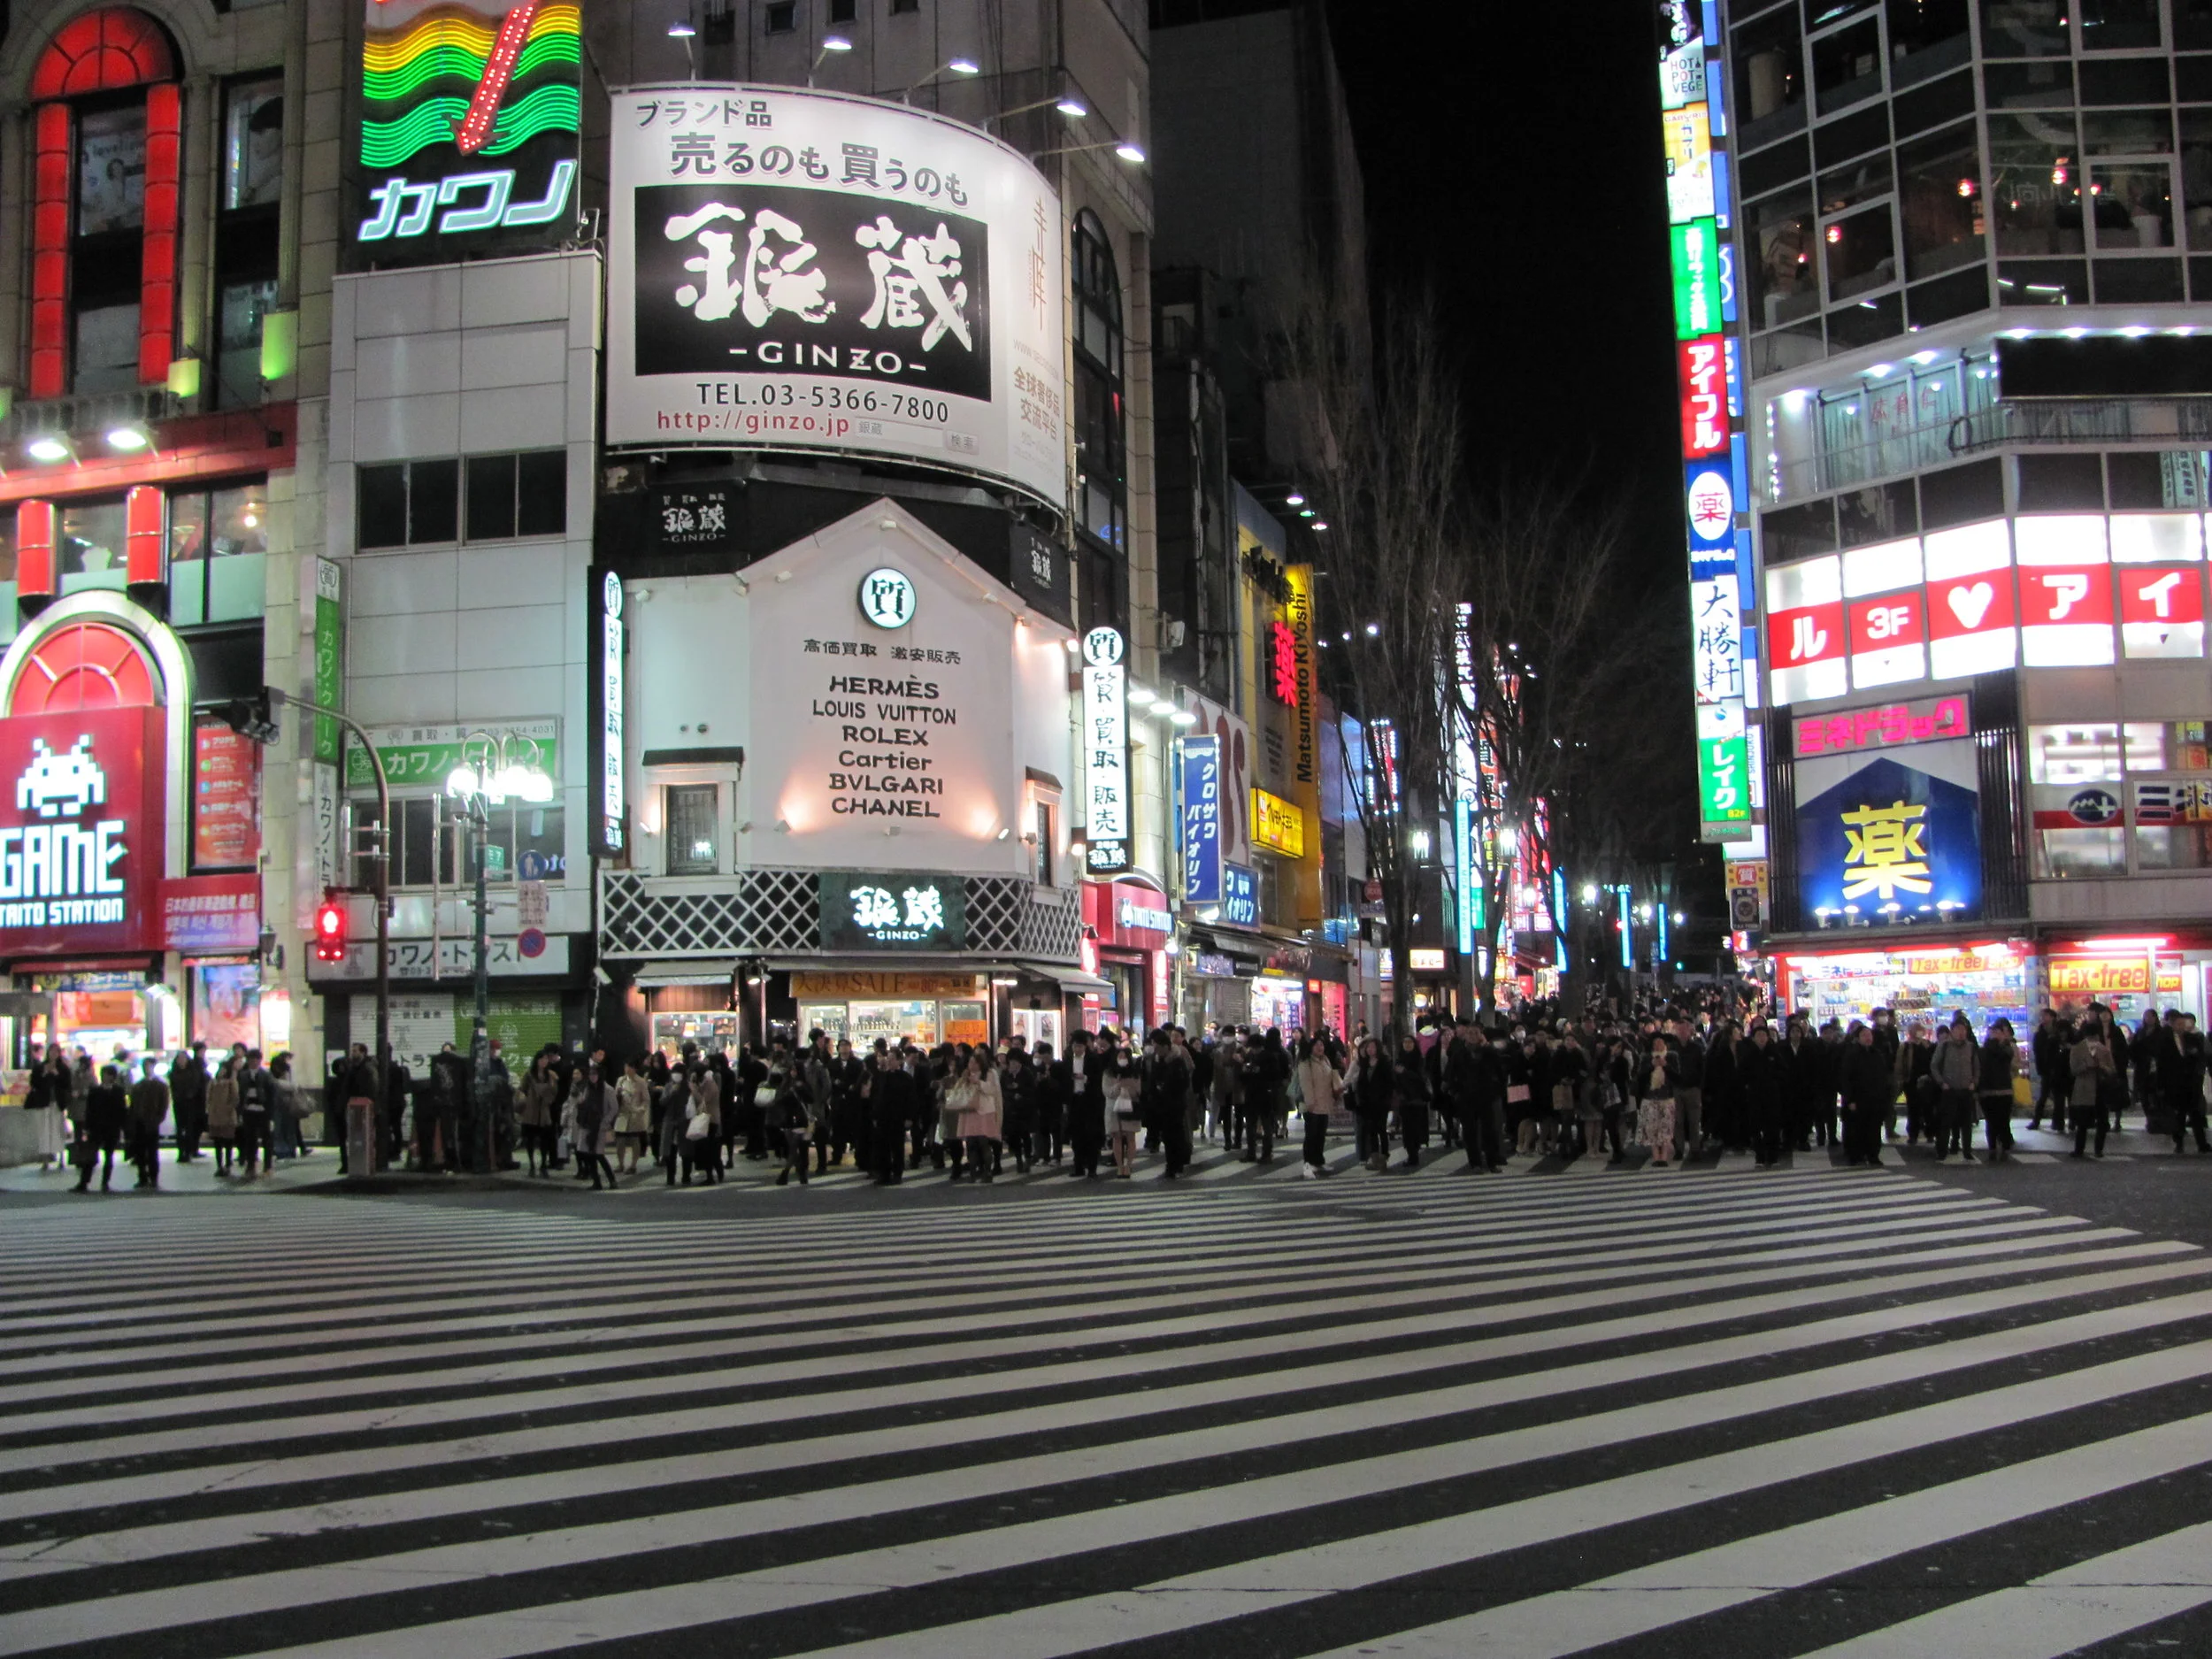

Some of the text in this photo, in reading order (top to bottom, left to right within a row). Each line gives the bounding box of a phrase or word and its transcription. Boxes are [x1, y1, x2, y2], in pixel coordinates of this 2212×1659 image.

[1671, 58, 1694, 71] HOT
[1671, 70, 1694, 81] POT
[1672, 81, 1703, 93] VEGE
[636, 99, 772, 129] ブランド品
[670, 131, 968, 206] 売るのも買うのも
[358, 159, 577, 241] カワノ
[664, 202, 972, 353] 銀蔵
[696, 382, 949, 423] TEL.03-5366-7800
[1688, 344, 1721, 449] アイフル
[657, 411, 849, 437] http://ginzo.jp
[1020, 397, 1057, 441] 交流平台
[1694, 492, 1726, 522] 薬
[871, 578, 906, 620] 質
[1790, 572, 2181, 660] ル 3F ア イ
[803, 639, 961, 664] 高価買取 激安販売
[1089, 631, 1116, 660] 質
[1699, 585, 1740, 692] 大勝軒
[322, 631, 333, 755] カワノ・クーク
[829, 674, 940, 699] HERMÈS
[812, 699, 956, 725] LOUIS VUITTON
[1296, 667, 1312, 783] Matsumoto
[842, 725, 929, 747] ROLEX
[838, 750, 933, 772] Cartier
[829, 772, 943, 795] BVLGARI
[1712, 744, 1736, 810] レイク
[832, 797, 941, 818] CHANEL
[1187, 762, 1217, 895] クロサワ バイオリン
[0, 819, 125, 898] GAME
[1839, 800, 1932, 900] 薬
[50, 897, 123, 925] STATION
[1916, 956, 1982, 973] Tax-free
[2054, 963, 2145, 988] Tax-free
